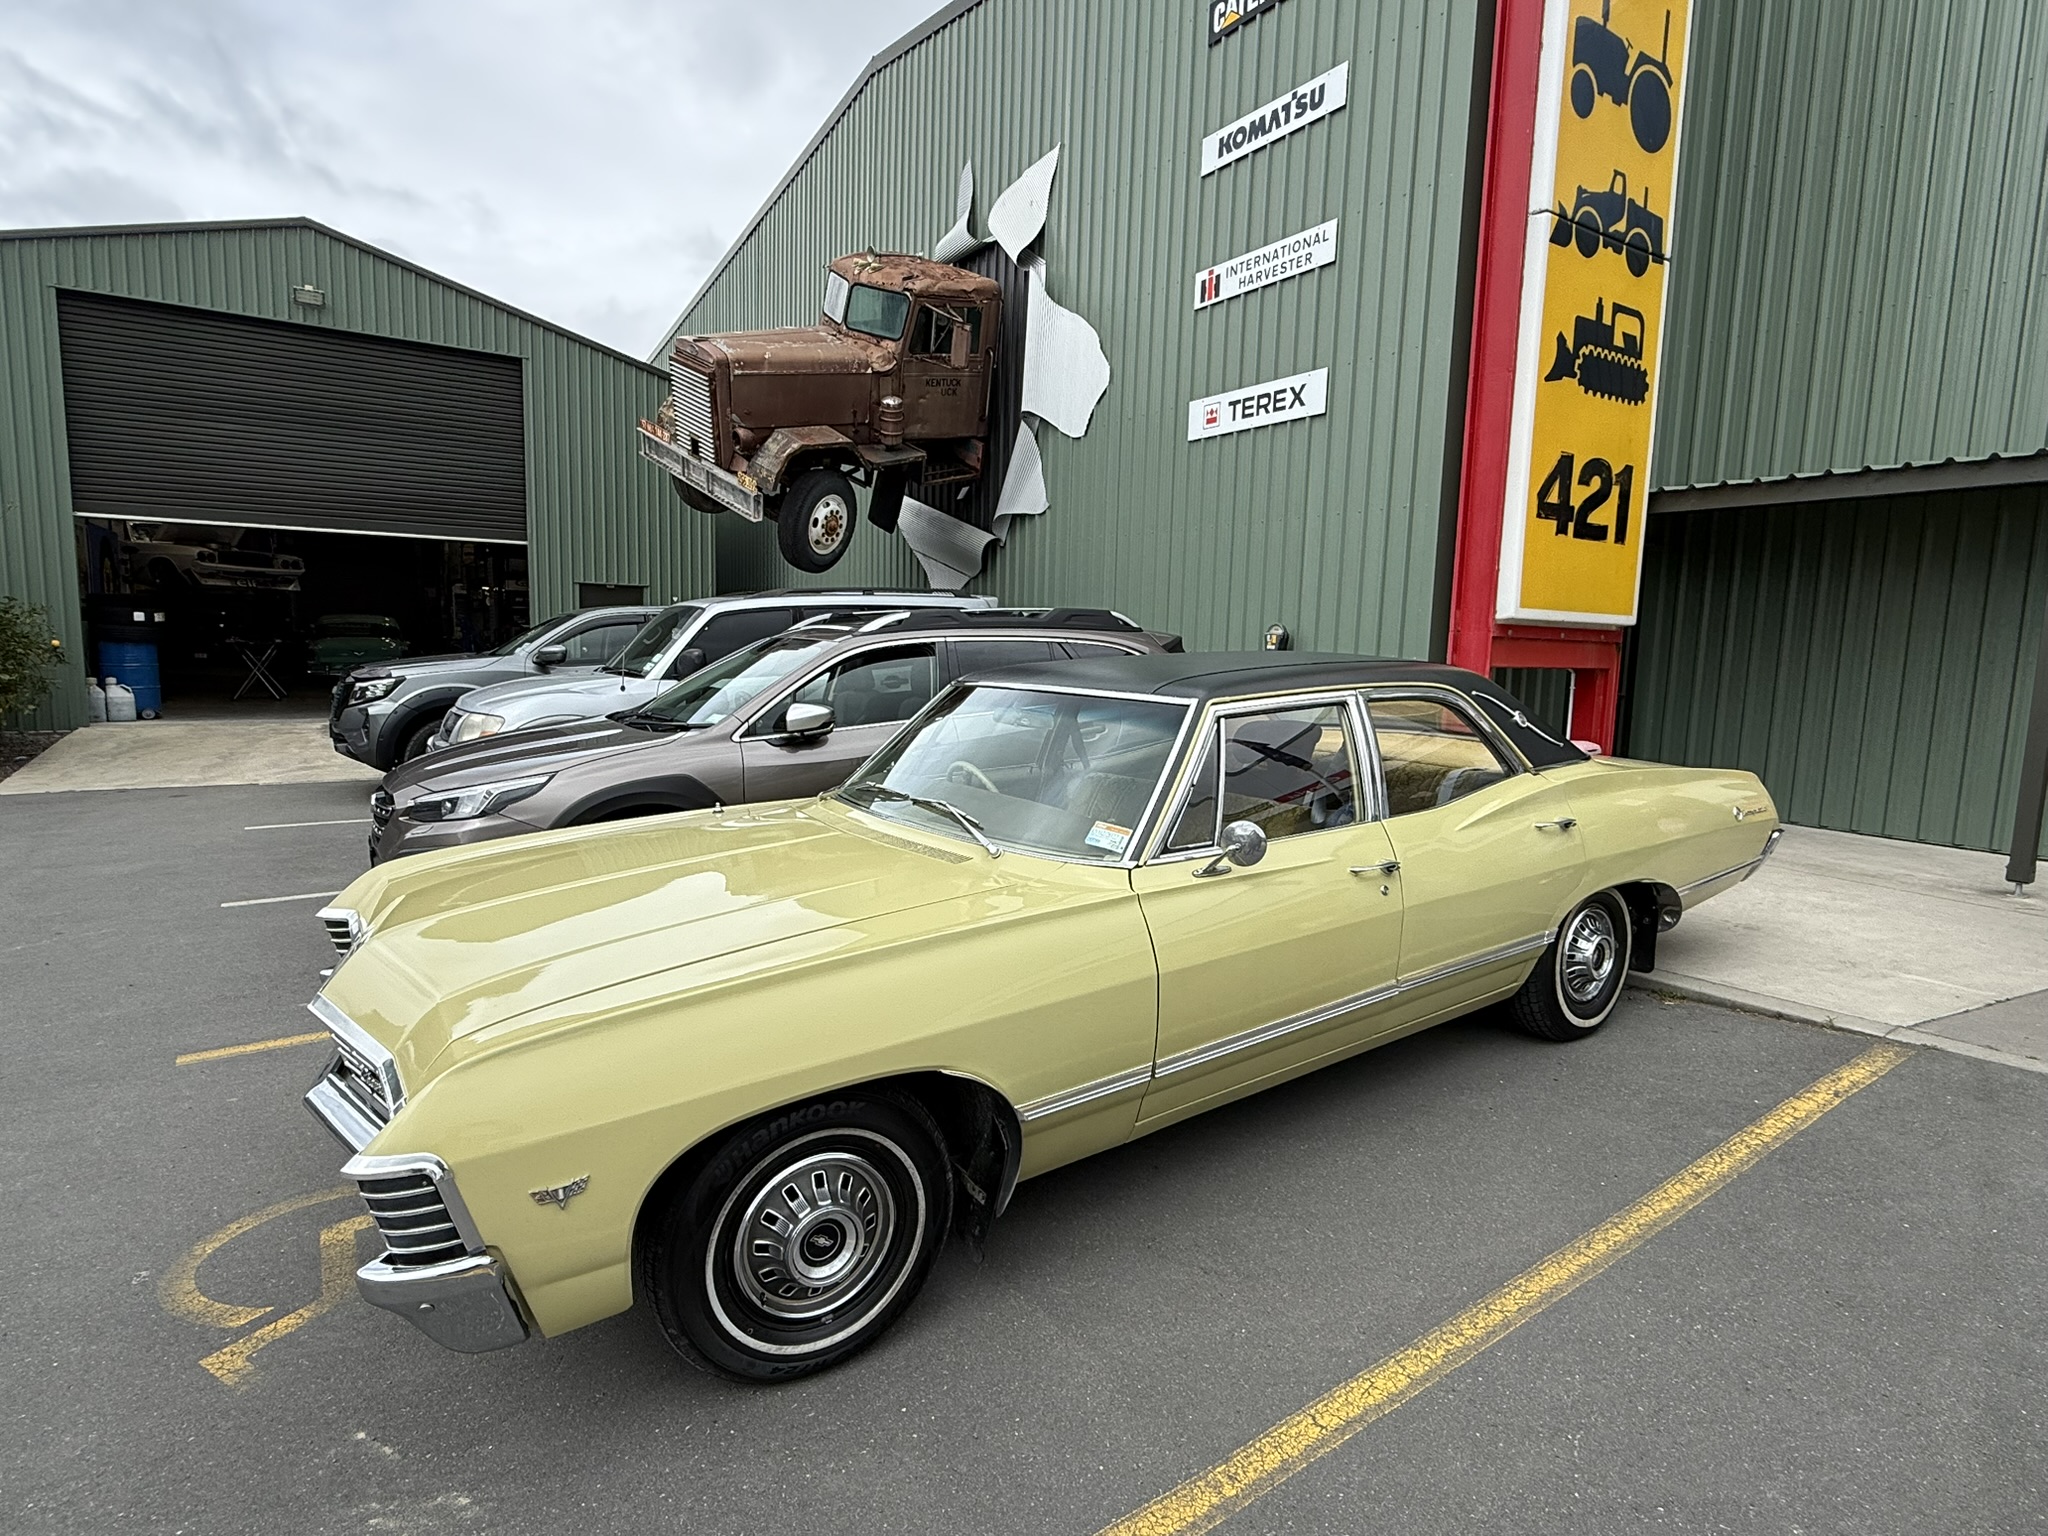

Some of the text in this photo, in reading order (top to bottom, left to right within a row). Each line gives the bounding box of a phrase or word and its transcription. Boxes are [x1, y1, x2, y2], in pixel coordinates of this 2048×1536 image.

[1217, 82, 1326, 159] KOMATSU
[1225, 229, 1330, 279] INTERNATIONAL
[1238, 252, 1313, 290] HARVESTER
[1228, 383, 1307, 422] TEREX
[1536, 450, 1634, 546] 421
